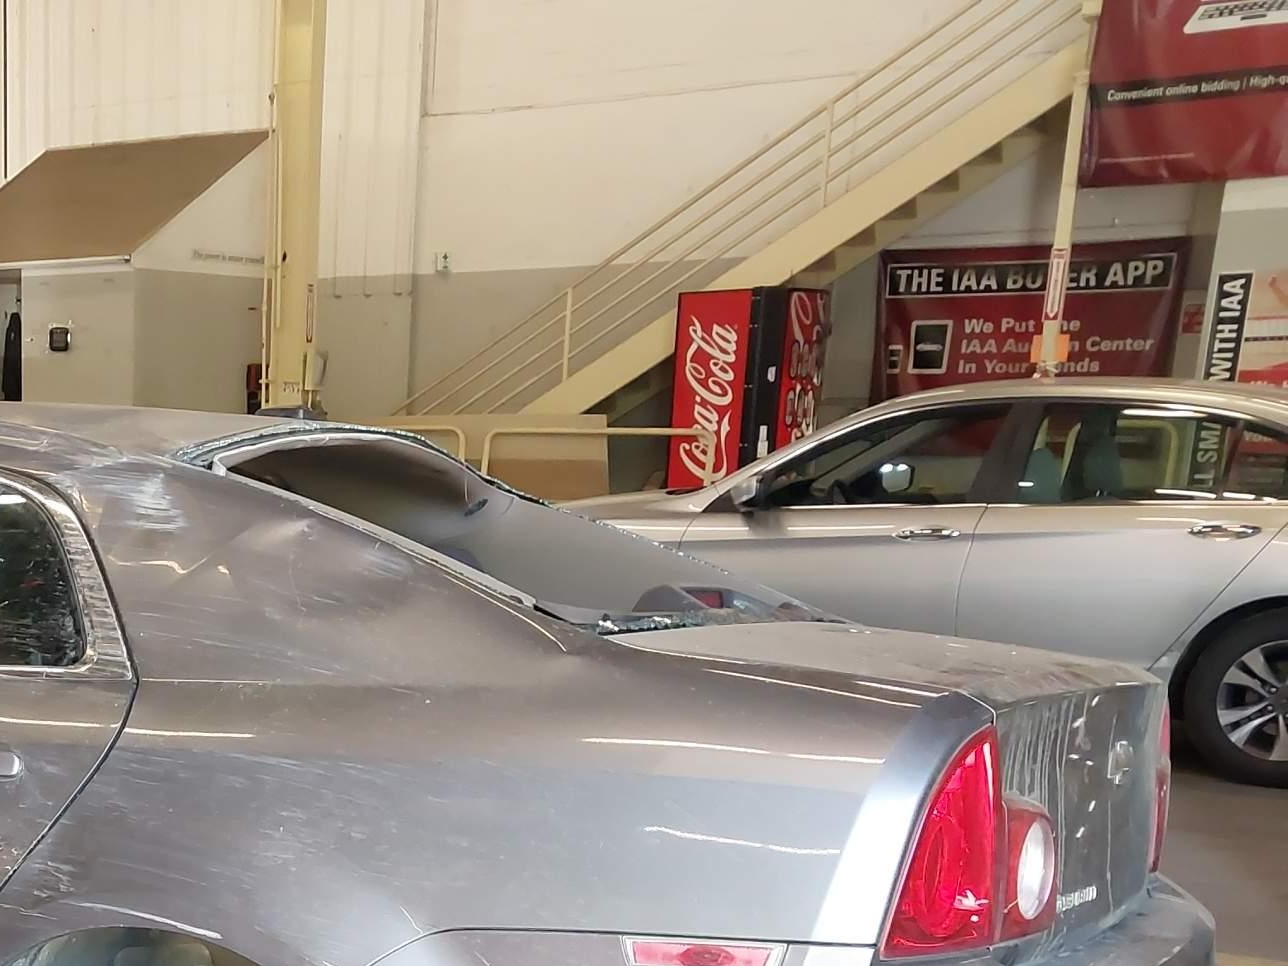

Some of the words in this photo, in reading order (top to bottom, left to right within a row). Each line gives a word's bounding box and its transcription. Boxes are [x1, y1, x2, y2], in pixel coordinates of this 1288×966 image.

[1107, 86, 1164, 101] Convenient
[1165, 82, 1199, 95] online
[1201, 78, 1240, 94] bidding
[896, 268, 945, 293] THE
[952, 266, 998, 291] IAA
[1006, 264, 1097, 289] BUER
[1104, 259, 1165, 288] APP
[1218, 278, 1247, 318] IAA
[964, 319, 992, 334] We
[1001, 317, 1035, 333] Put
[961, 338, 998, 354] IAA
[1086, 335, 1155, 352] Center
[1208, 323, 1239, 381] WITH
[958, 360, 977, 374] In
[984, 359, 1028, 374] Your
